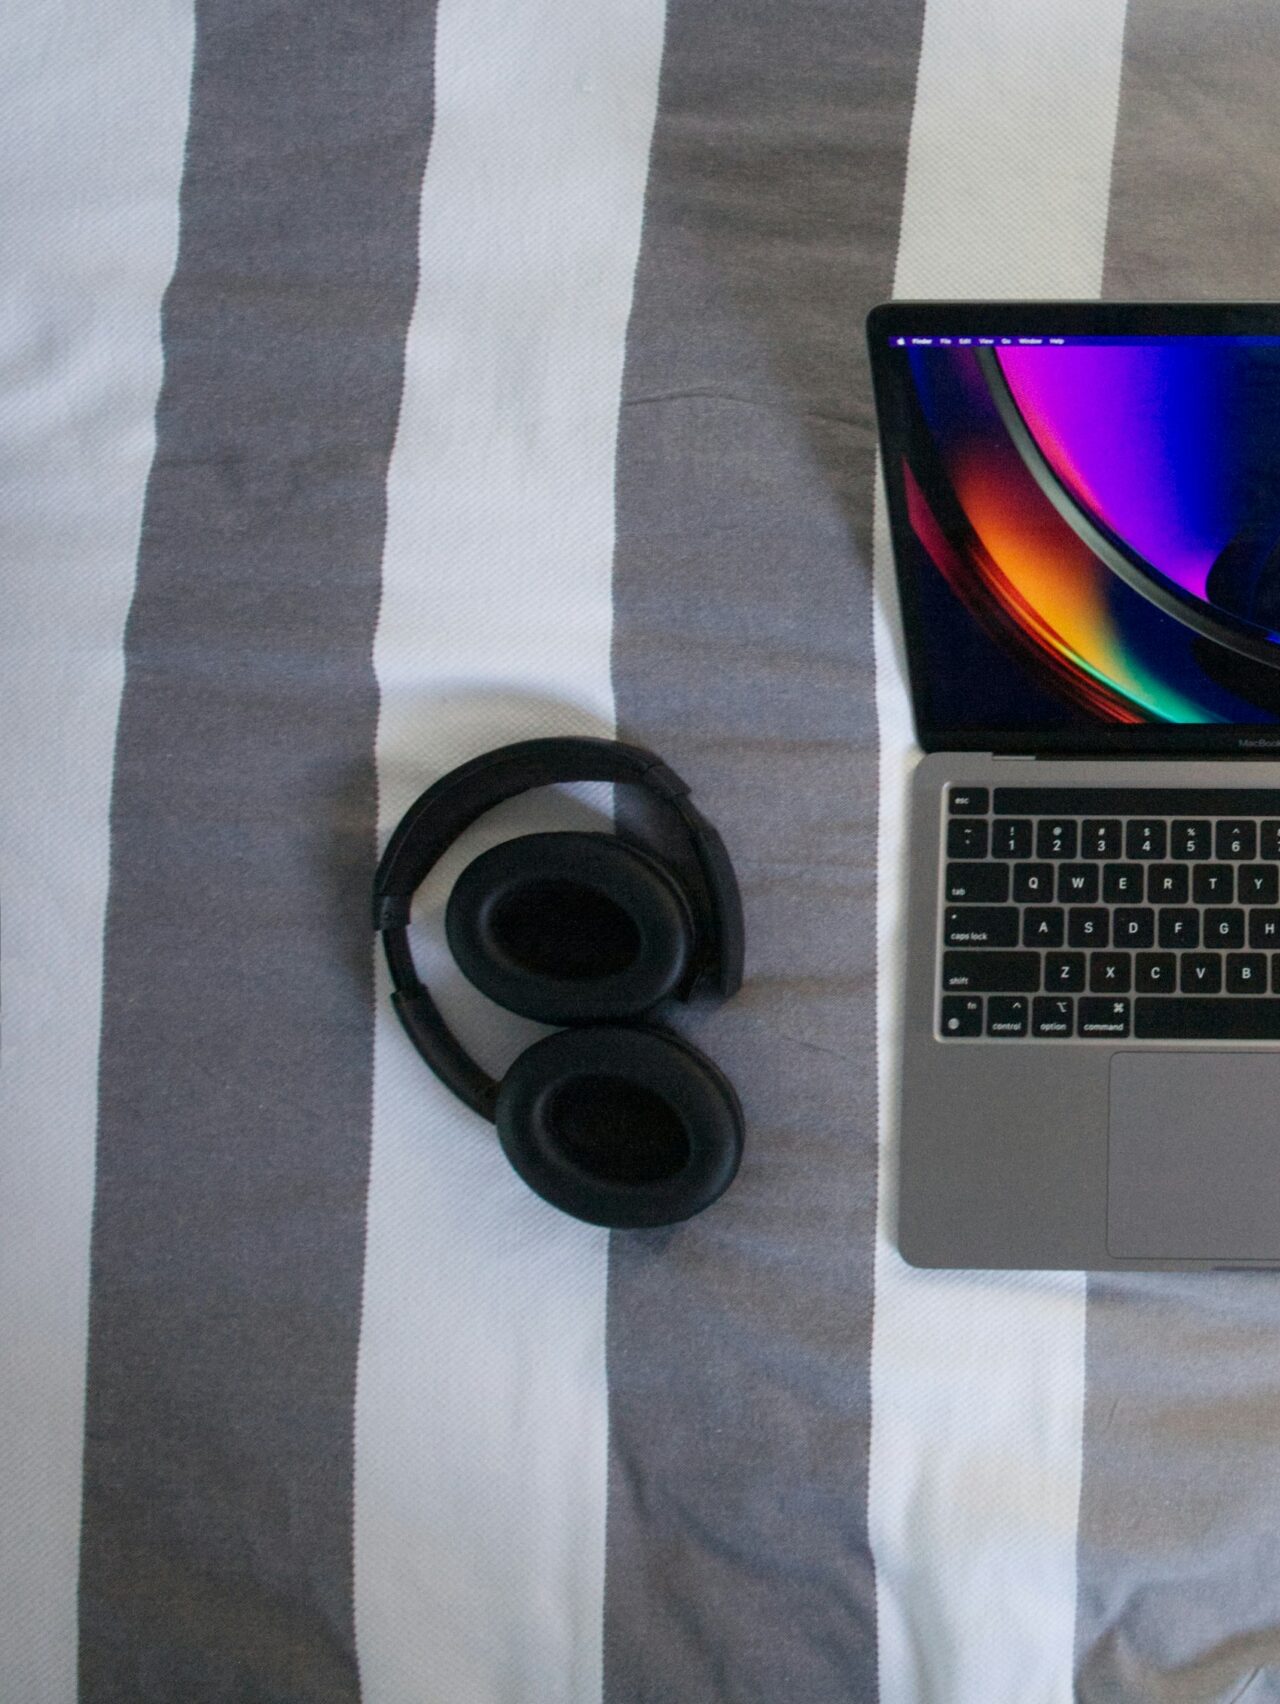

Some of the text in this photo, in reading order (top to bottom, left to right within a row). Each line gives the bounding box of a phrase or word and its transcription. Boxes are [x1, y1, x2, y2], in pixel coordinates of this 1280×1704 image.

[954, 797, 969, 805] esc
[1008, 839, 1015, 851] 1
[1053, 839, 1062, 852] 2
[1097, 839, 1106, 852] 3
[1142, 840, 1151, 852] 4
[1186, 840, 1196, 852] 5
[1231, 840, 1241, 853] 6
[1028, 876, 1039, 890] Q
[1071, 877, 1085, 889] W
[1118, 877, 1127, 890] E
[1163, 877, 1173, 889] R
[1209, 877, 1218, 890] T
[1254, 878, 1263, 890] Y
[951, 887, 966, 896] tab
[1038, 921, 1049, 933] A
[1084, 921, 1094, 934] S
[1128, 921, 1139, 934] D
[1174, 922, 1183, 934] F
[1219, 922, 1229, 935] G
[1264, 923, 1275, 935] H
[950, 932, 987, 941] caps lock
[1060, 966, 1070, 979] Z
[1105, 966, 1115, 978] X
[1150, 966, 1161, 979] C
[1195, 967, 1206, 979] V
[1241, 967, 1252, 979] B
[949, 976, 969, 985] shift
[967, 1001, 977, 1010] fn
[992, 1021, 1022, 1031] control
[1040, 1022, 1067, 1032] option
[1083, 1022, 1124, 1031] command
